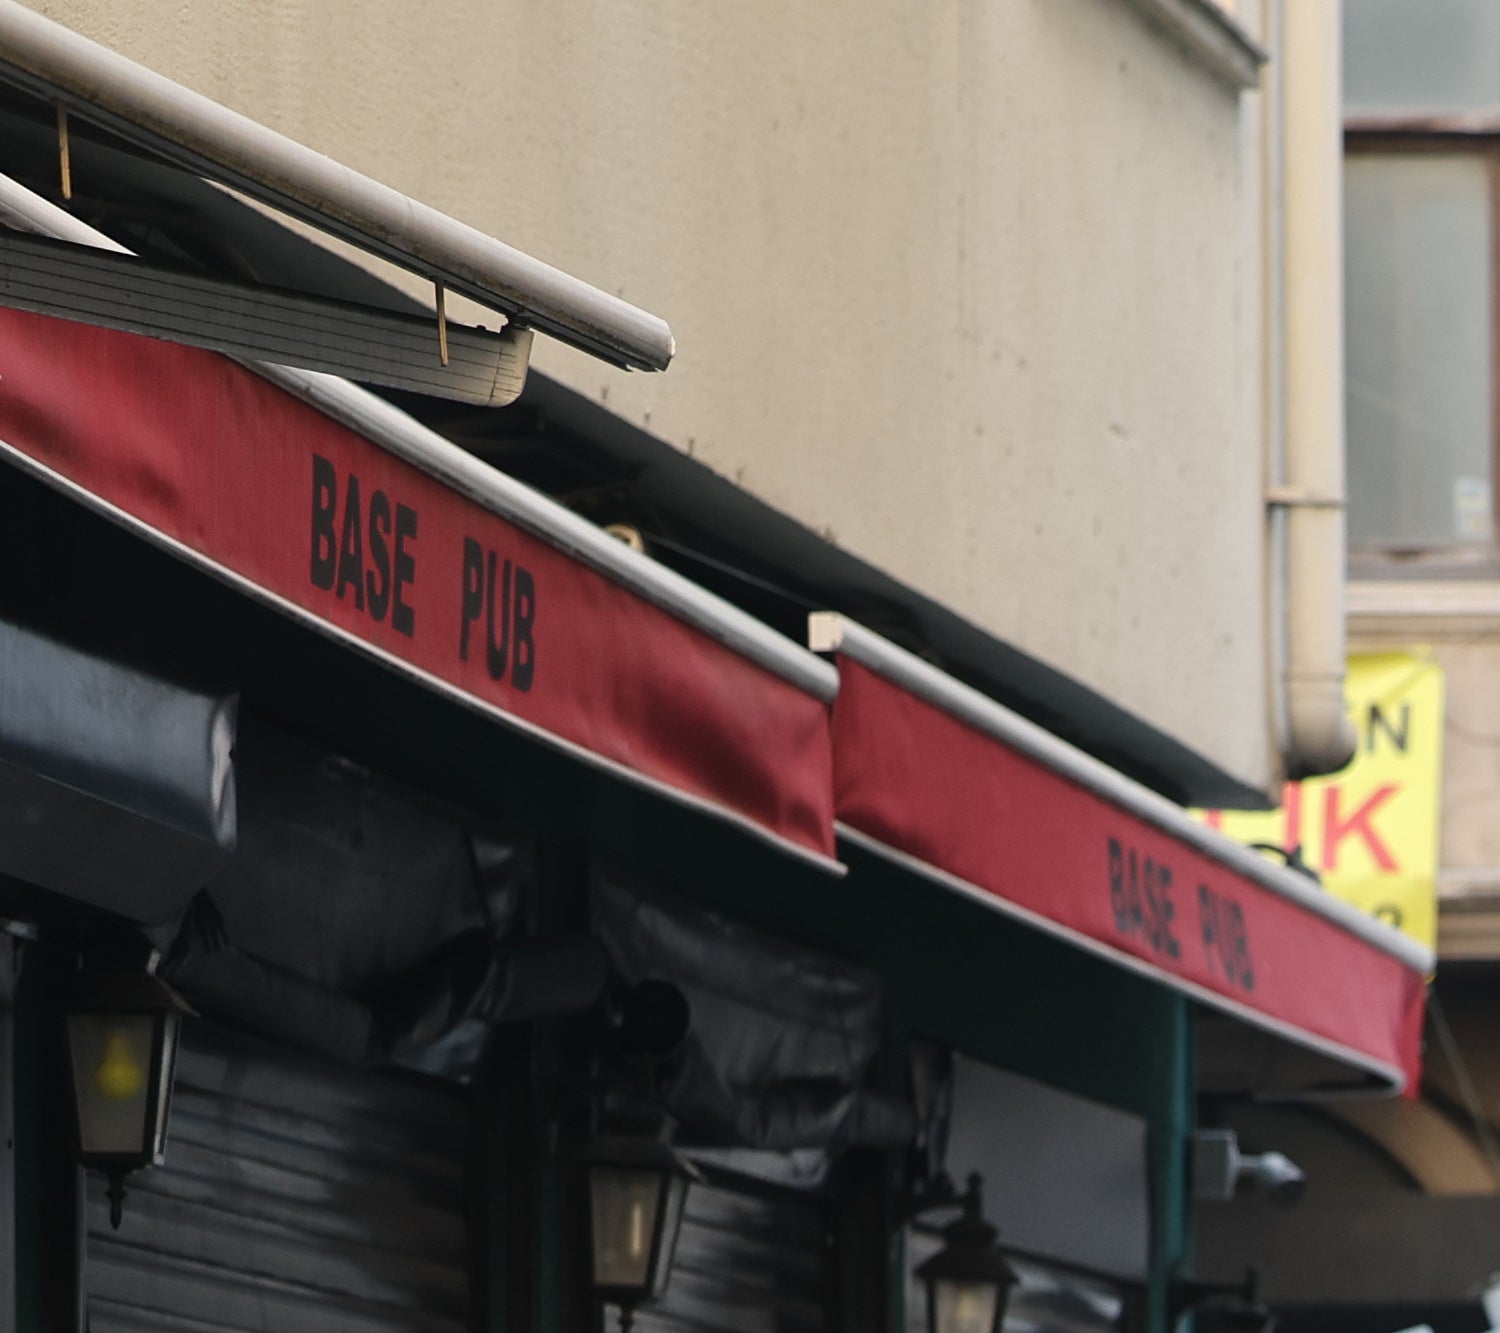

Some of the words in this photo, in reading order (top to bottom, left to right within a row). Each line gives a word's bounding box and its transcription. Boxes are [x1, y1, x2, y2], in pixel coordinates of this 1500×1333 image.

[310, 452, 418, 639] BASE
[459, 535, 535, 692] PUB
[1108, 837, 1180, 959] BASE
